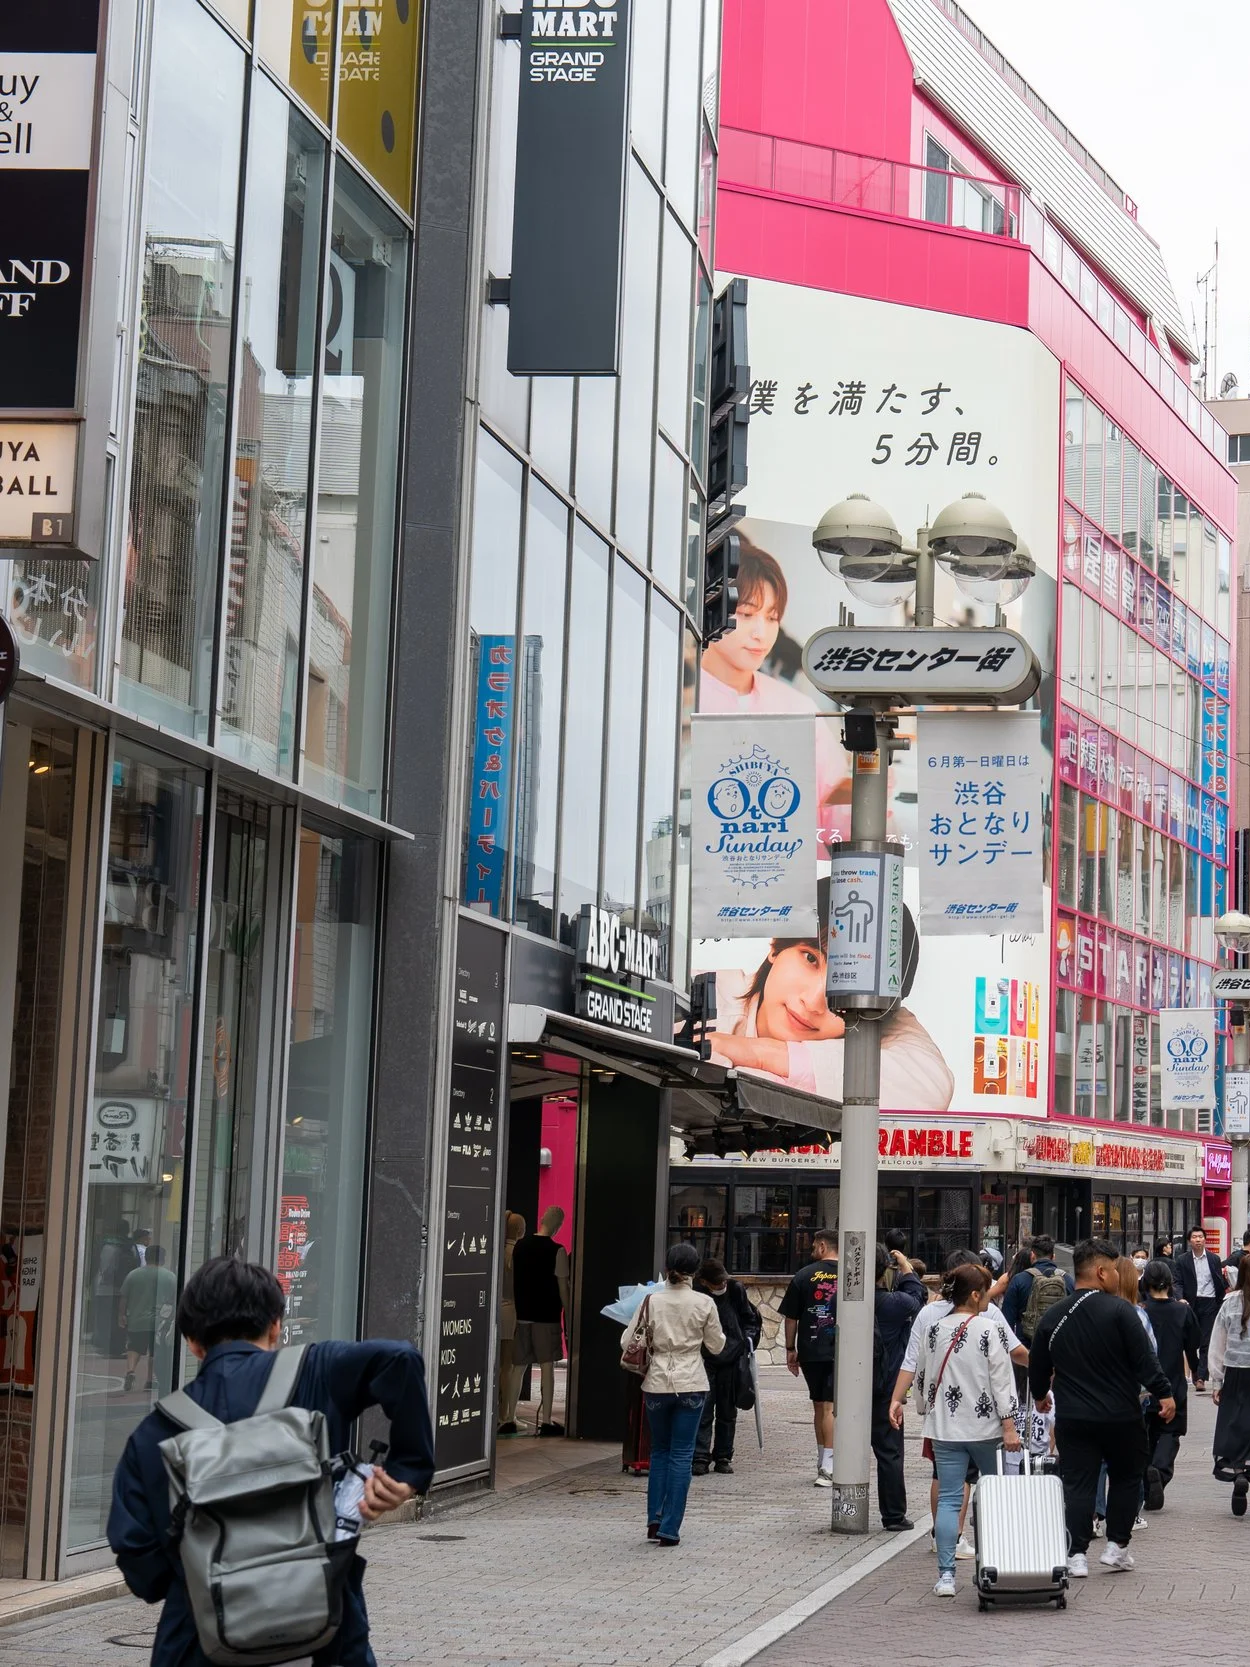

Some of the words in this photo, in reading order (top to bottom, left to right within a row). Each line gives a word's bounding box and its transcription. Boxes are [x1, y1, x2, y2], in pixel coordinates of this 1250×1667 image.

[531, 11, 618, 37] MART
[530, 51, 605, 66] GRAND
[529, 67, 597, 82] STAGE
[0, 441, 41, 462] YA
[871, 431, 1003, 468] 5分間。
[42, 519, 63, 536] B1
[812, 645, 1016, 675] 渋谷センター街
[927, 755, 1030, 768] 6月第一日曜日は
[954, 780, 1007, 806] 渋谷
[929, 811, 1030, 836] おとなり
[705, 833, 804, 860] Sunday
[929, 840, 1033, 867] サンデー
[840, 868, 858, 877] throw
[891, 863, 900, 901] SAFE
[717, 905, 793, 917] 渋谷センター街
[944, 902, 1019, 914] 渋谷センター街
[586, 904, 659, 980] ABC-MART
[889, 919, 898, 969] CLEAN
[587, 990, 623, 1026] GRAND
[623, 1001, 653, 1034] STAGE
[771, 1157, 819, 1165] BURGERS,
[810, 1270, 838, 1282] Japan
[442, 1318, 473, 1337] WOMENS
[440, 1348, 457, 1366] KIDS
